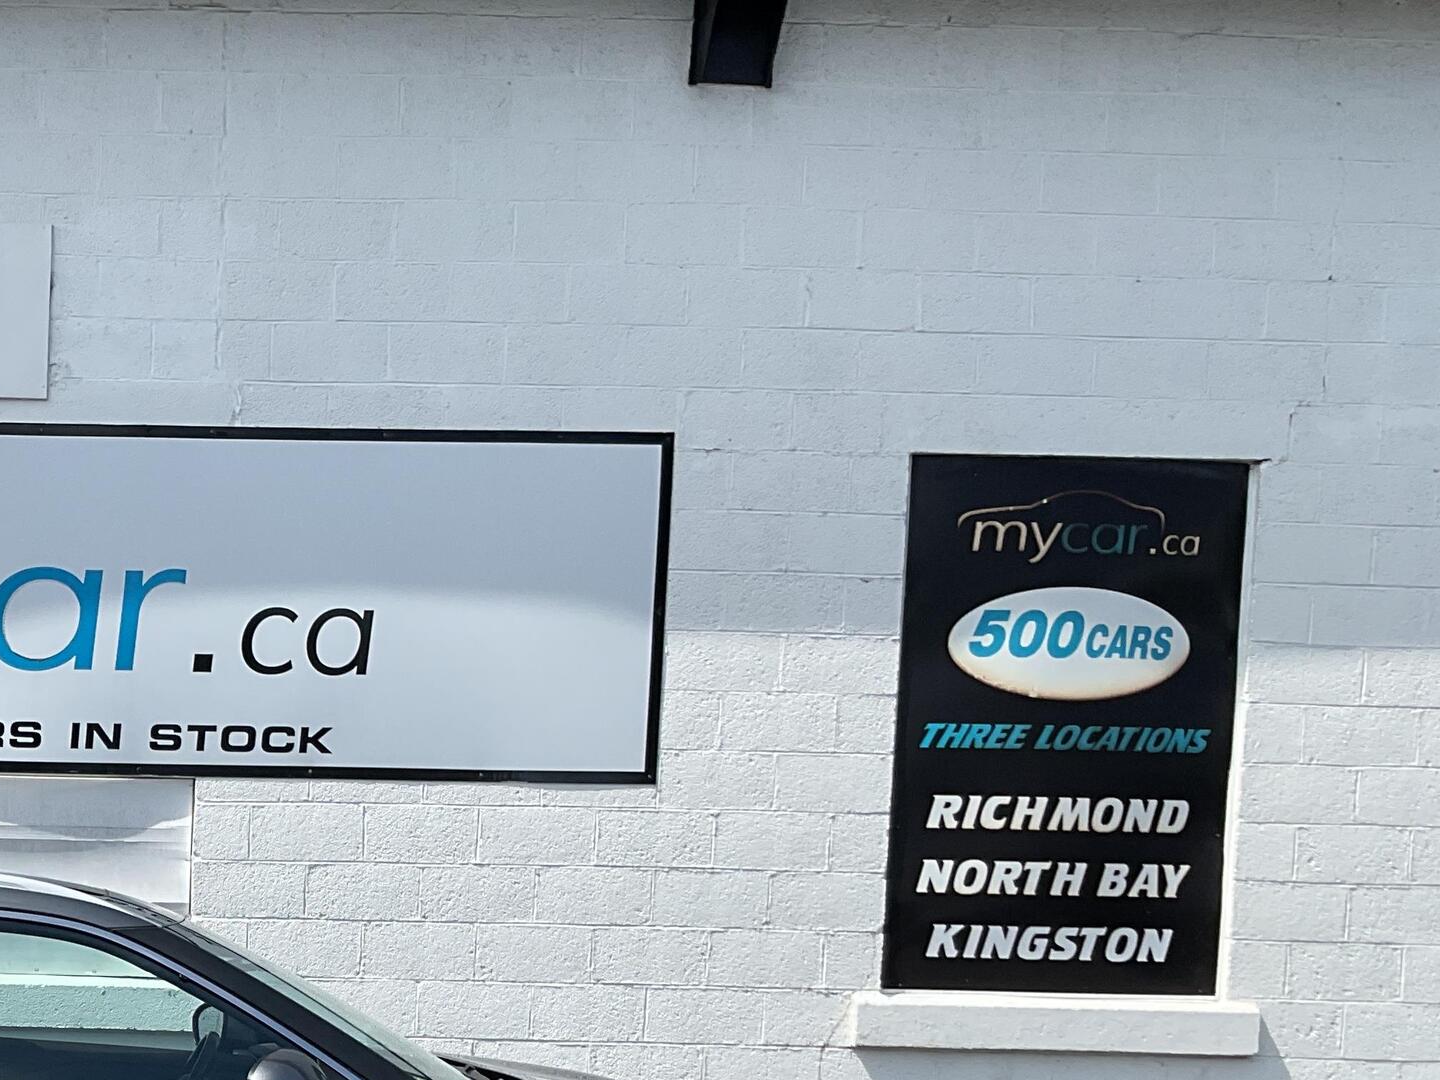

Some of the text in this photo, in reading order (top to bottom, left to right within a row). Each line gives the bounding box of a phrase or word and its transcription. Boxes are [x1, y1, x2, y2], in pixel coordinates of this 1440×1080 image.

[971, 516, 1200, 563] mycar.ca
[968, 609, 1173, 661] 500 CARS
[69, 722, 122, 750] IN
[149, 723, 333, 755] STOCK
[919, 723, 1211, 754] THREE LOCATIONS
[926, 794, 1190, 834] RICHMOND
[915, 858, 1191, 899] NORTH BAY
[926, 924, 1173, 962] KINGSTON
